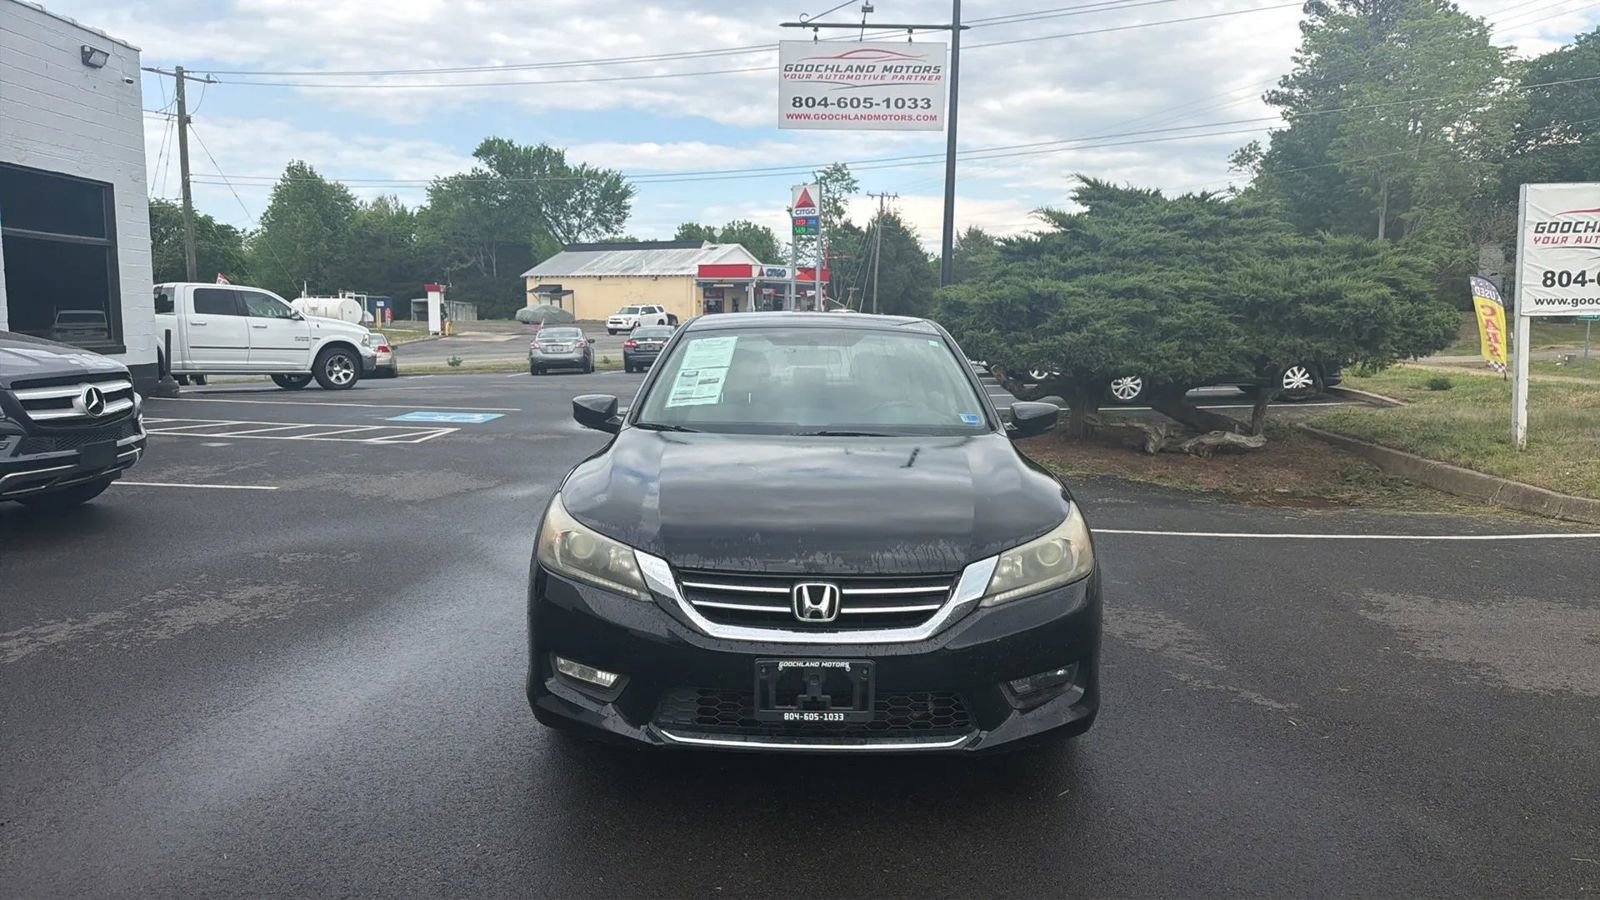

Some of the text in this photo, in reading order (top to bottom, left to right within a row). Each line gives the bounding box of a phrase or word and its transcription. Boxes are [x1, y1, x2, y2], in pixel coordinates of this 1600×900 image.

[784, 63, 942, 74] GOOCHLAND MOTORS
[791, 96, 932, 110] 804-605-1033
[786, 112, 938, 122] WWW.GOOCHLANDMOTORS.COM
[1534, 221, 1600, 233] GOOCH
[1533, 236, 1569, 244] YOUR
[783, 712, 845, 721] 804-605-1033
